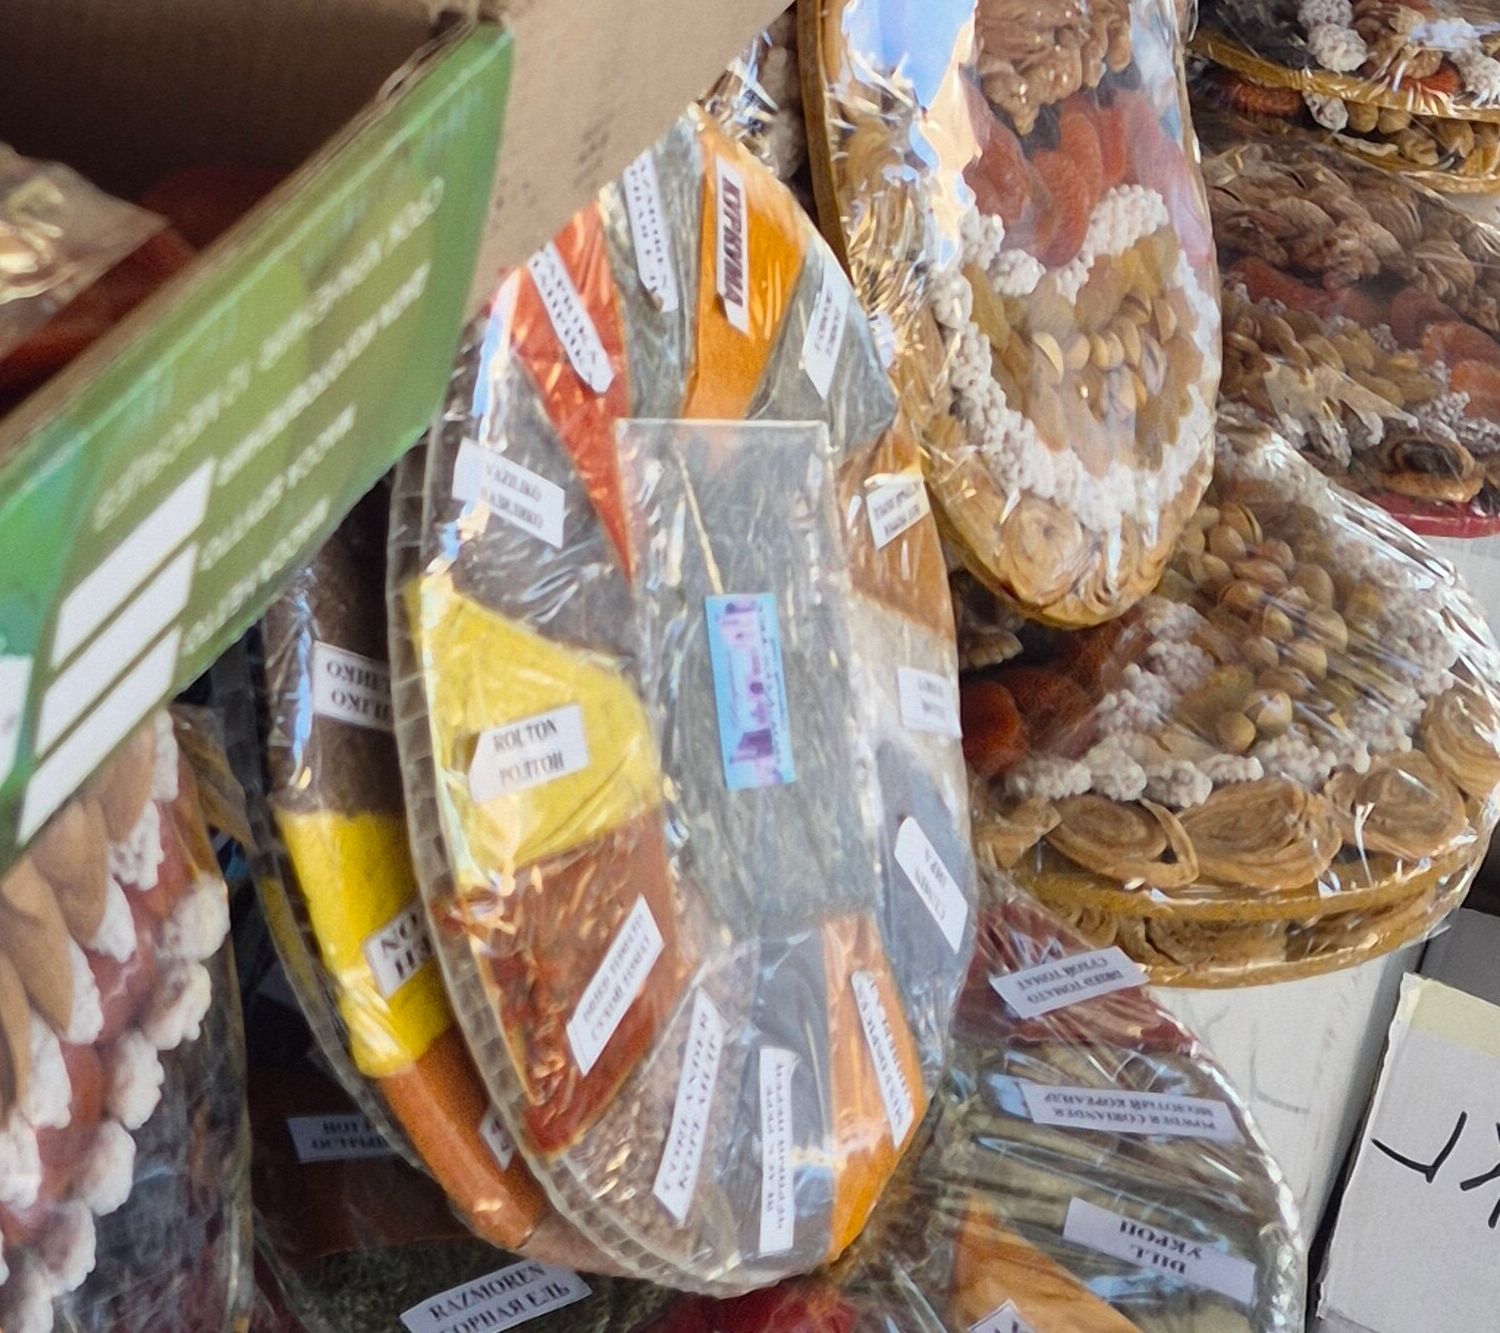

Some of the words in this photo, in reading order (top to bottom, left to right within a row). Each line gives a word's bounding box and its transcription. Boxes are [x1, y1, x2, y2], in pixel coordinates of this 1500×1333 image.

[718, 175, 747, 307] КУРКУМА
[490, 717, 558, 753] ROLTON
[1119, 1217, 1202, 1261] УКРОП
[1128, 1242, 1185, 1276] DILL
[429, 1262, 548, 1322] RAZMOREN
[438, 1298, 526, 1333] ОРНАЯ
[526, 1282, 571, 1307] ЕЛЬ
